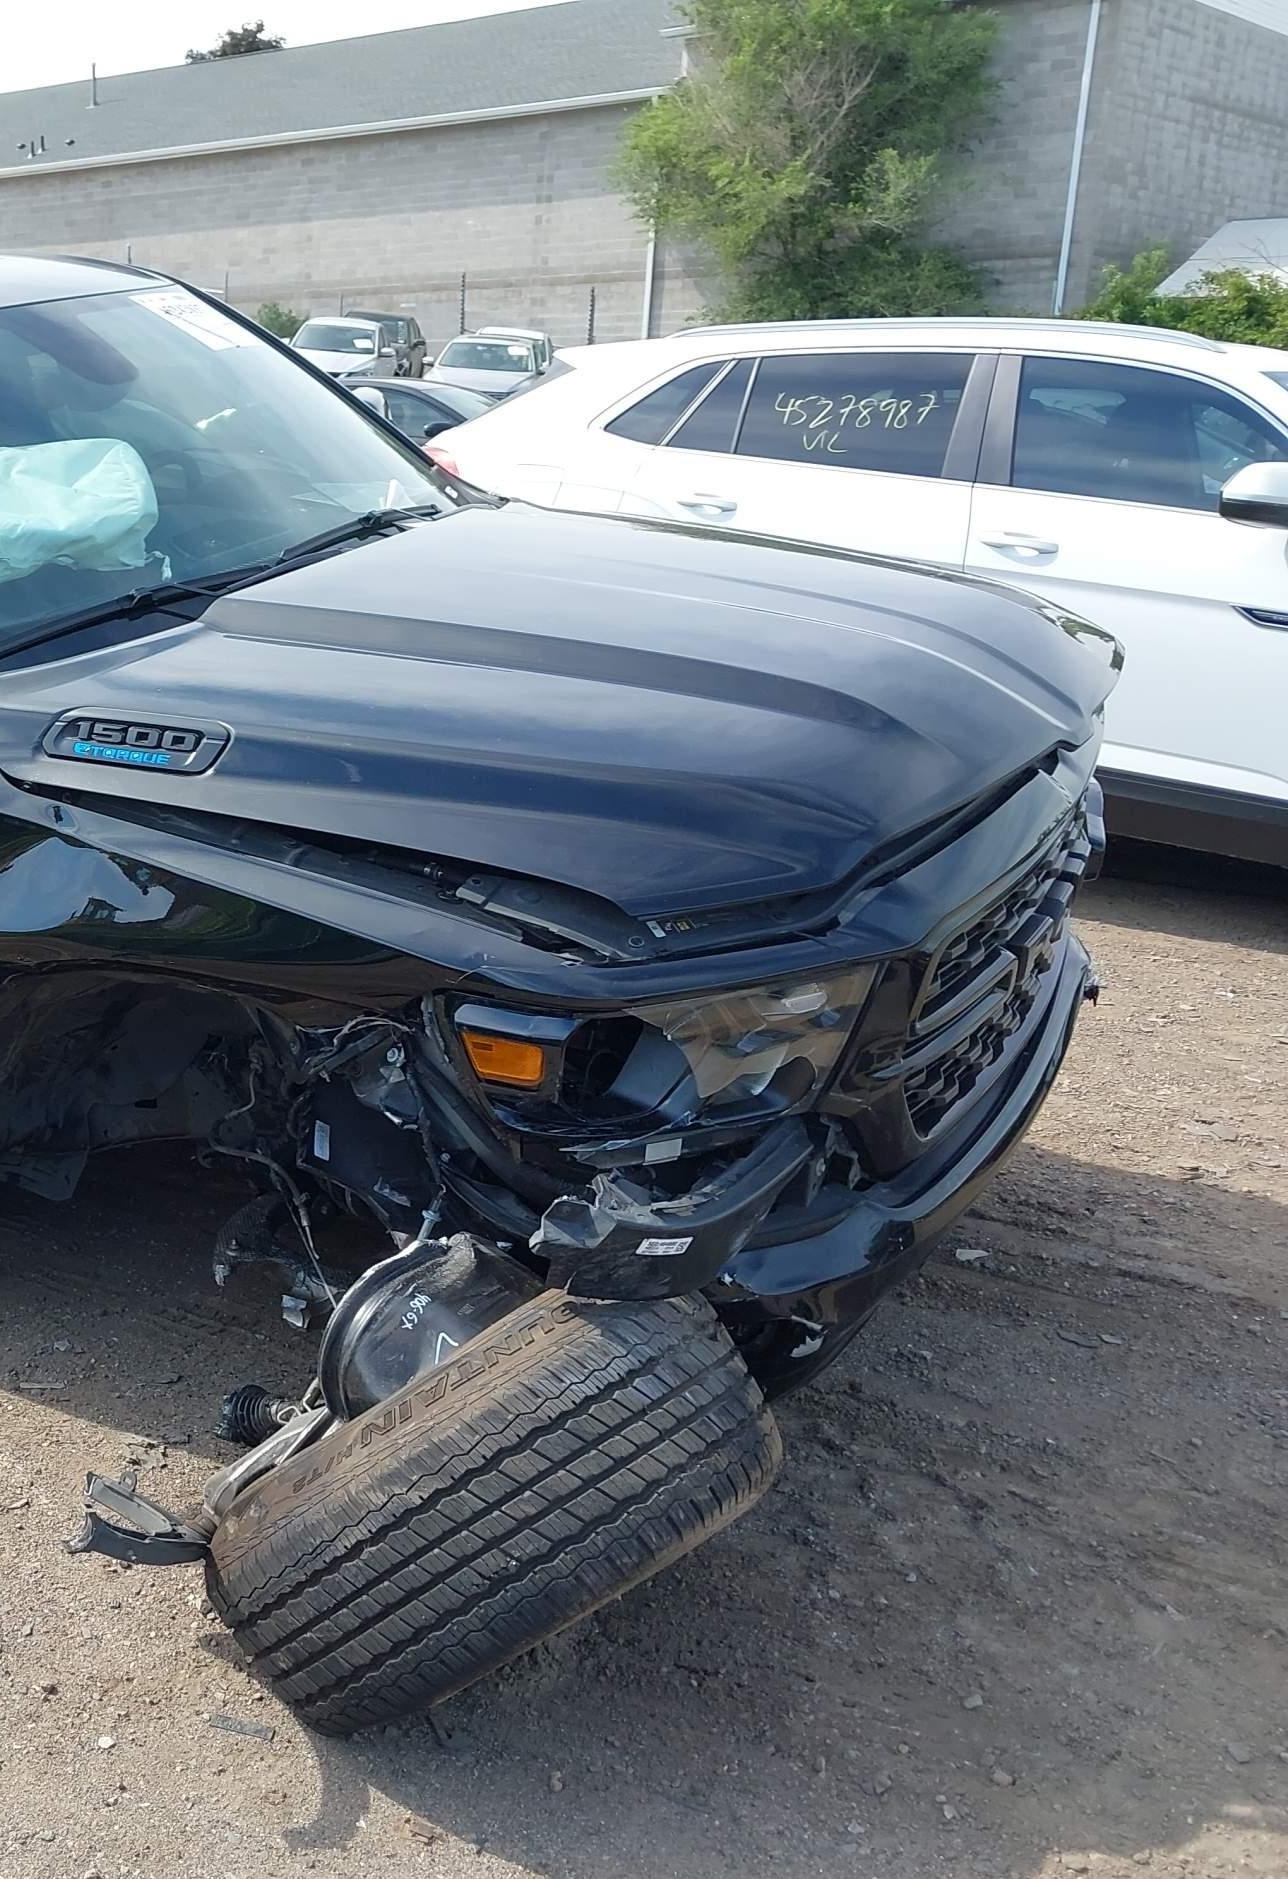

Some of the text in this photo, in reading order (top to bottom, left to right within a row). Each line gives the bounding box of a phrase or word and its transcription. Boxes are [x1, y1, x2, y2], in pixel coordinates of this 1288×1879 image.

[774, 392, 940, 429] 45278987
[76, 719, 198, 752] 1500
[360, 1303, 580, 1449] OUNTAIN
